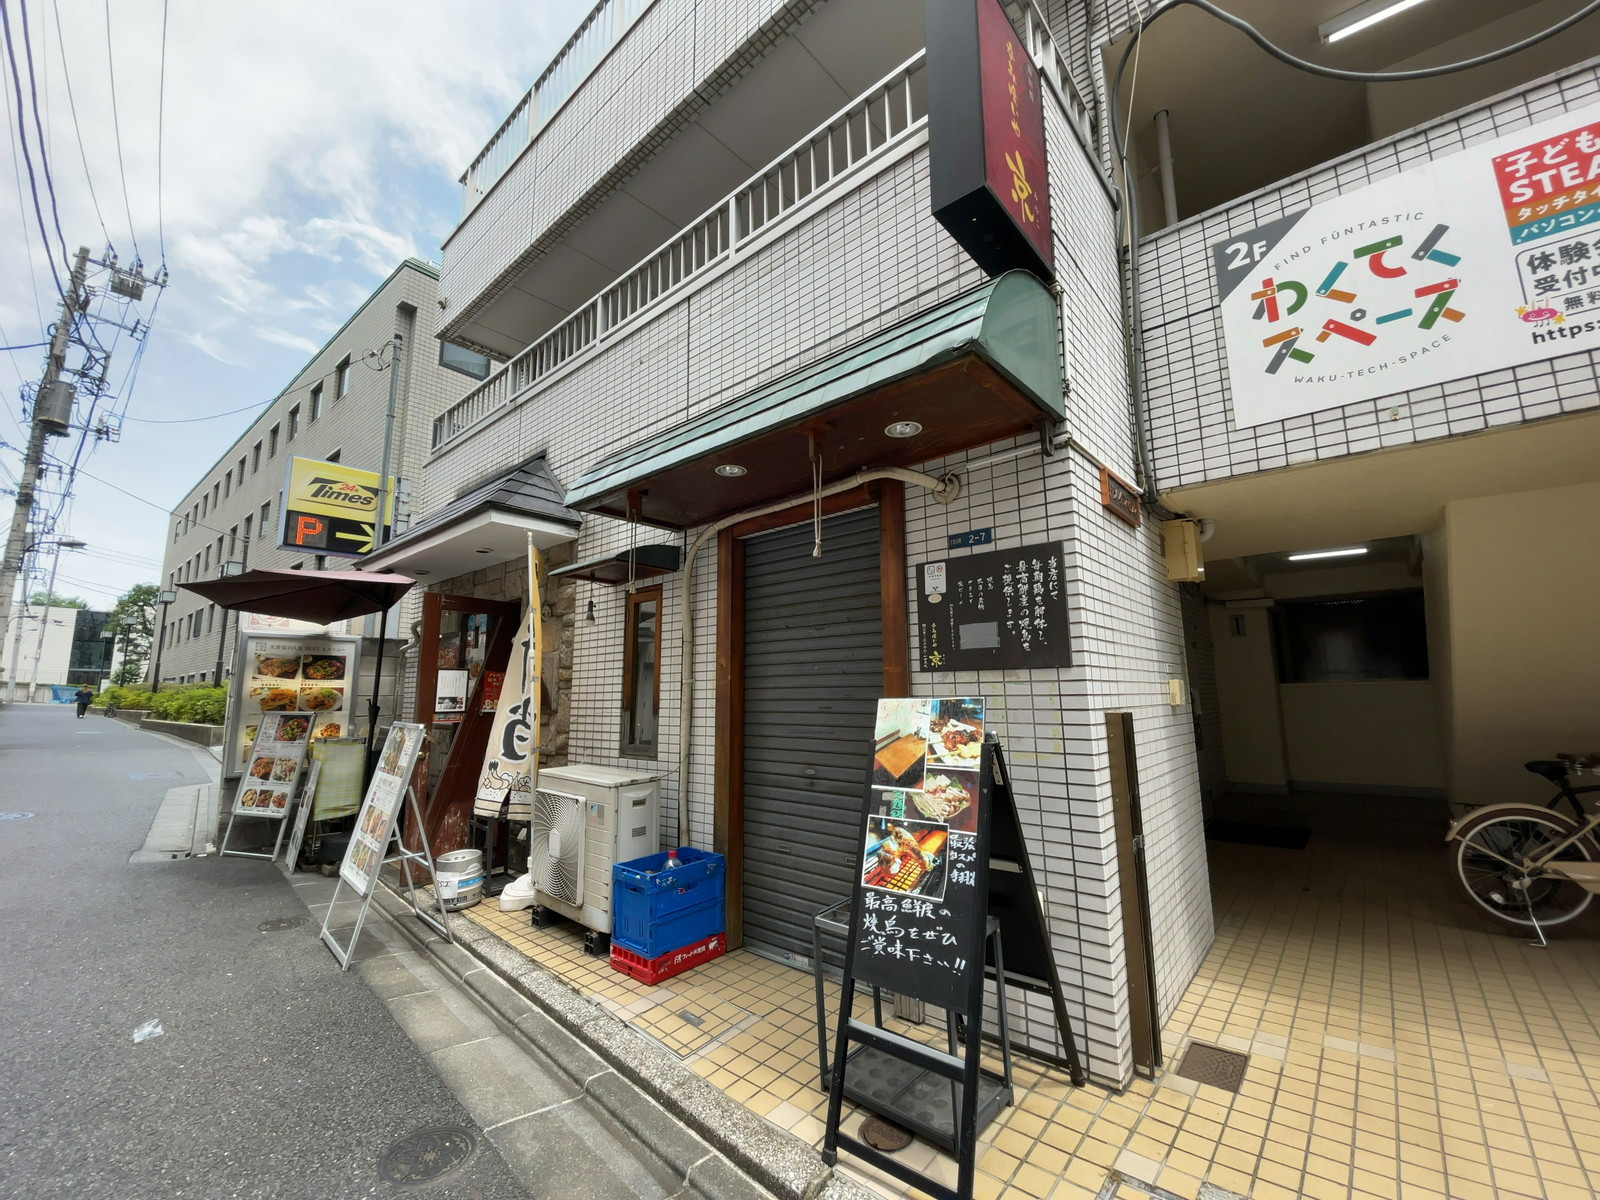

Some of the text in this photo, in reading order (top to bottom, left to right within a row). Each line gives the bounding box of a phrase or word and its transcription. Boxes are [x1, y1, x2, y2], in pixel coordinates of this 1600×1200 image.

[1504, 130, 1600, 177] 子ども
[1225, 240, 1267, 270] 2F
[1274, 212, 1425, 271] FIND FÜNTASTIC
[1251, 223, 1462, 323] わくてく
[1262, 277, 1466, 375] スペース
[1293, 334, 1452, 384] WAKU-TECH-SPACE
[307, 476, 376, 505] Times
[295, 515, 323, 545] P
[968, 532, 986, 544] 2-7
[1047, 555, 1059, 600] 当店にて
[864, 891, 952, 919] 最高鮮度の
[863, 913, 958, 946] 焼鳥をぜひ
